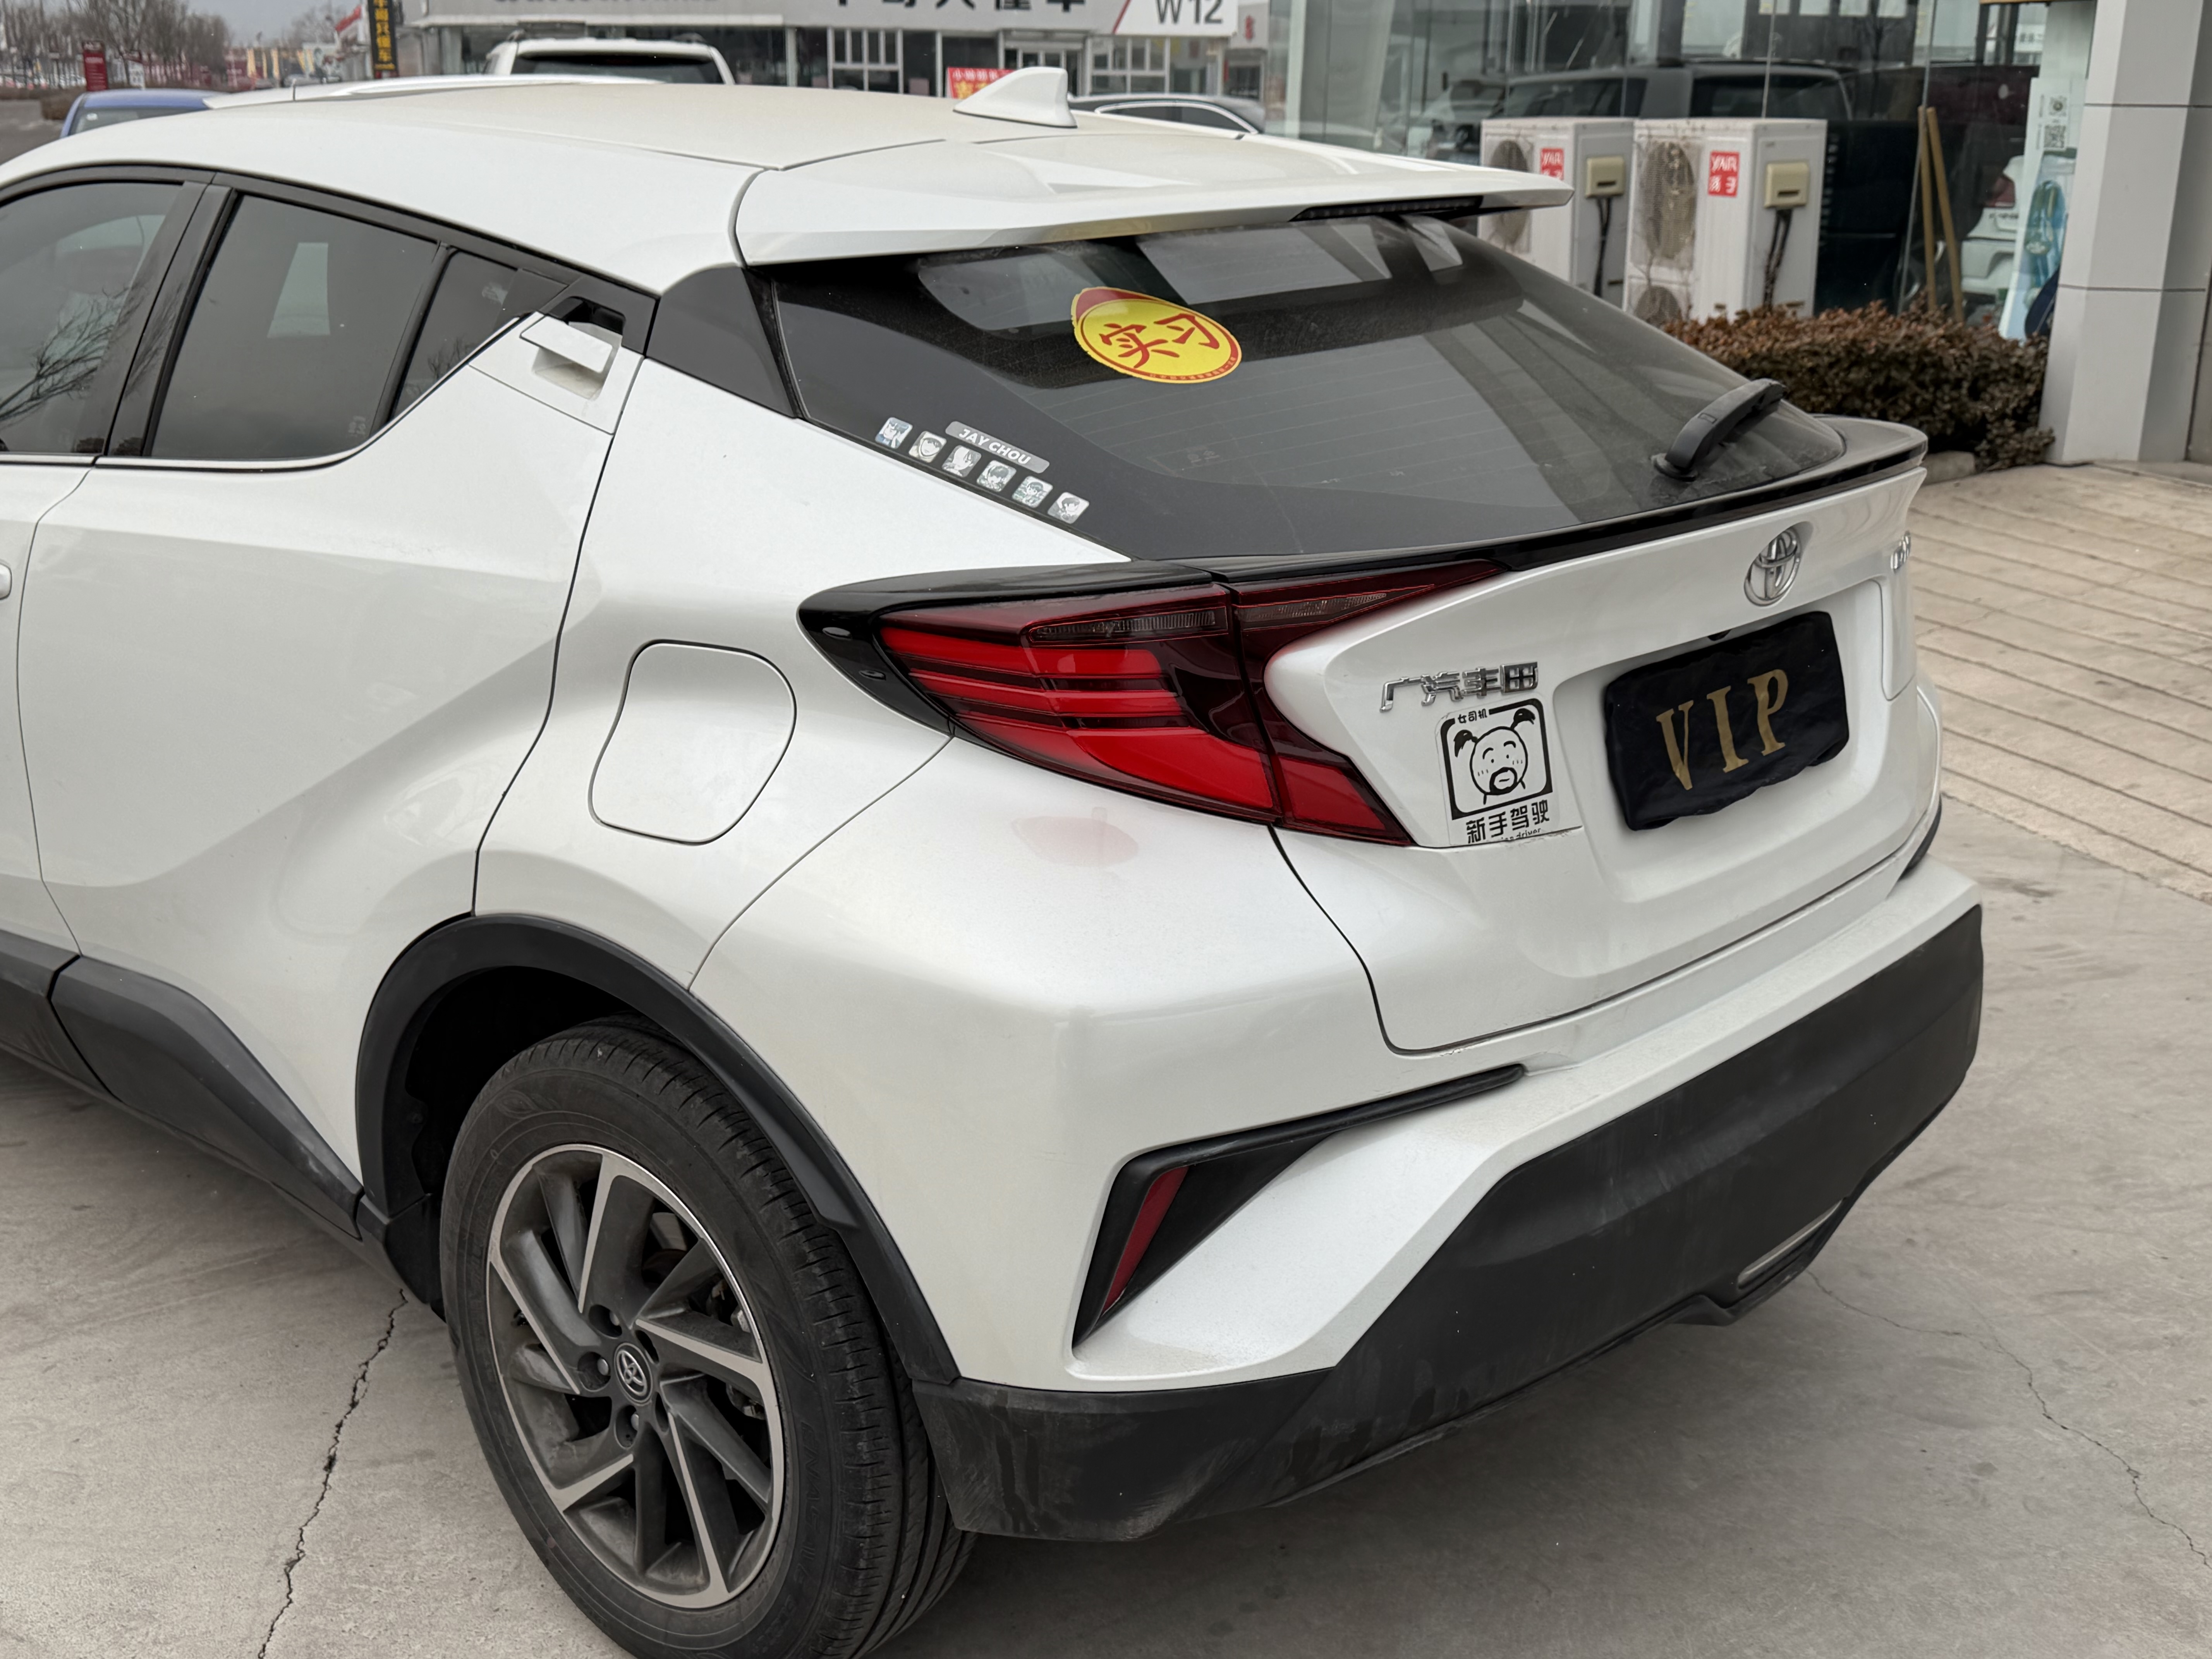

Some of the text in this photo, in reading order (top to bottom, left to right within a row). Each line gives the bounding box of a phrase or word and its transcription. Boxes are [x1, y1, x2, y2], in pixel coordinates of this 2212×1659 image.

[1099, 313, 1220, 368] 实习
[958, 428, 1031, 464] JAY CHOU
[1379, 661, 1539, 713] 广汽丰田
[1457, 708, 1488, 724] 女司机
[1656, 669, 1789, 791] VIP
[1466, 799, 1550, 844] 新手驾驶
